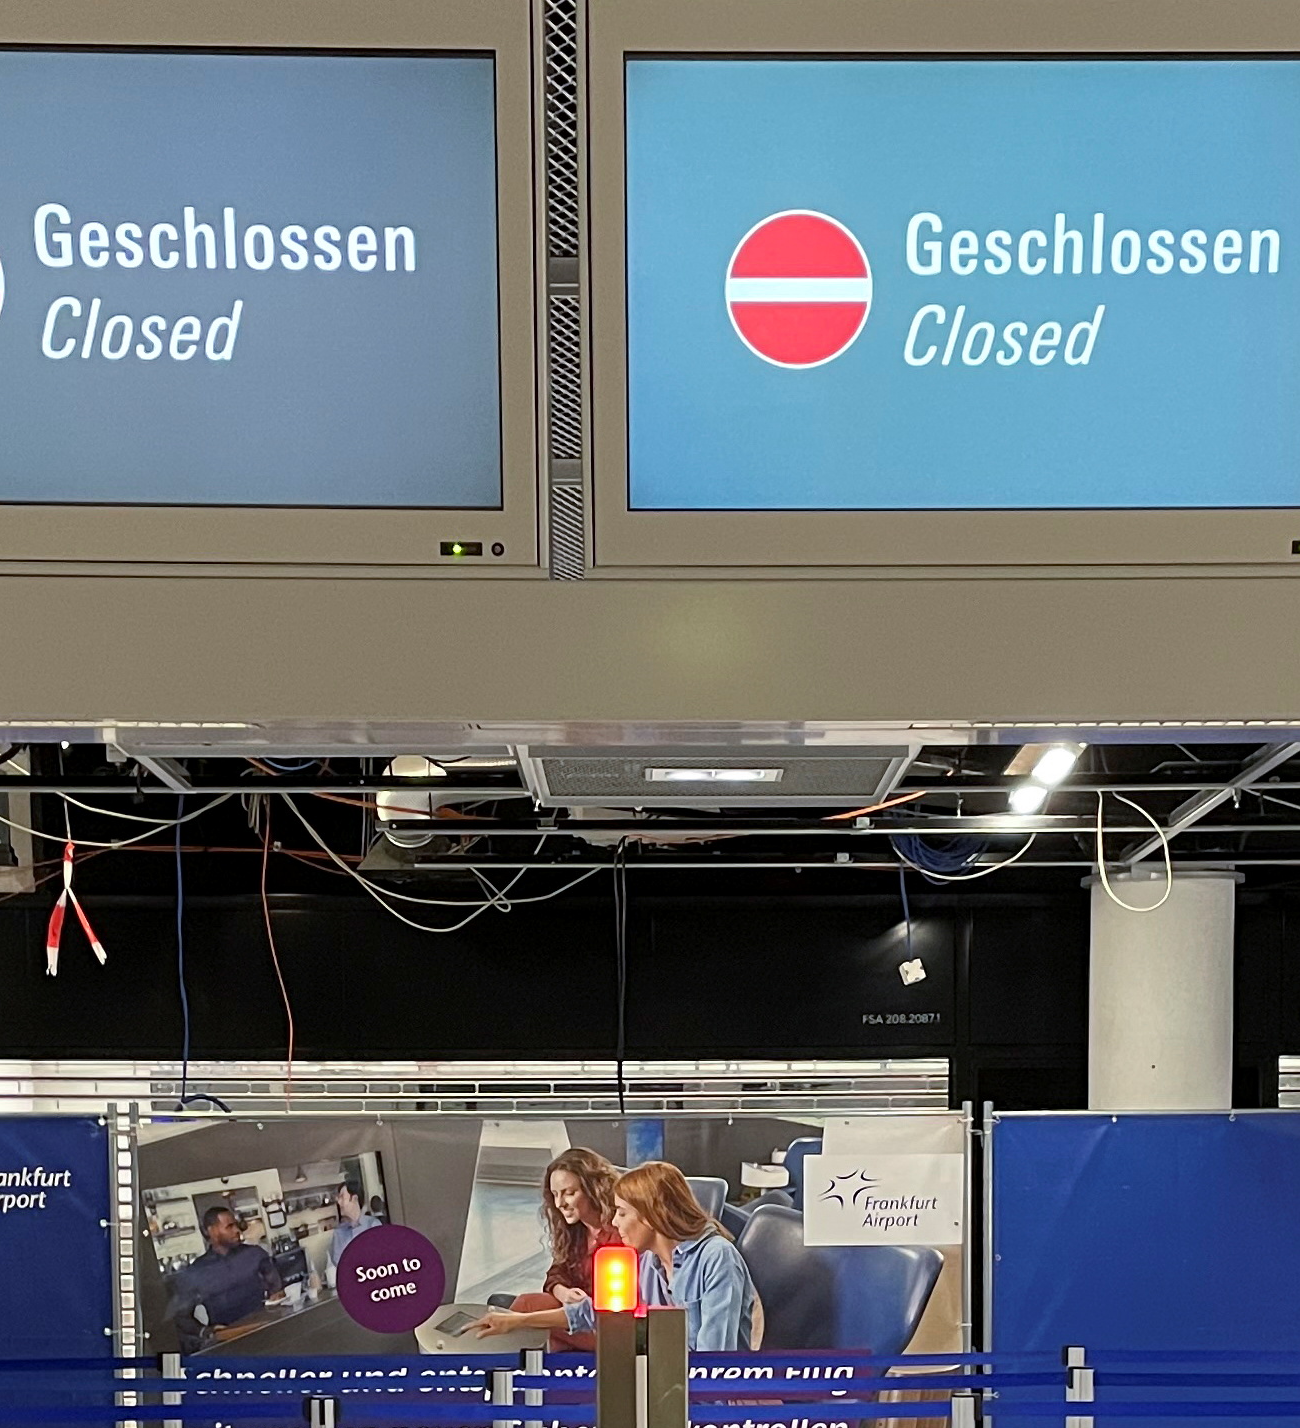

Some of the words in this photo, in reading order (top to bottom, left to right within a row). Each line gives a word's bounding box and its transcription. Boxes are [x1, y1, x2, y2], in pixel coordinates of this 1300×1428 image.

[33, 203, 416, 272] Geschlossen
[905, 211, 1280, 275] Geschlossen
[41, 296, 243, 361] Closed
[903, 304, 1105, 366] Closed
[862, 1014, 884, 1024] FSA
[864, 1195, 938, 1210] Frankfurt
[861, 1212, 918, 1231] Airport
[355, 1263, 399, 1283] Soon
[402, 1258, 421, 1272] to
[370, 1282, 417, 1302] come
